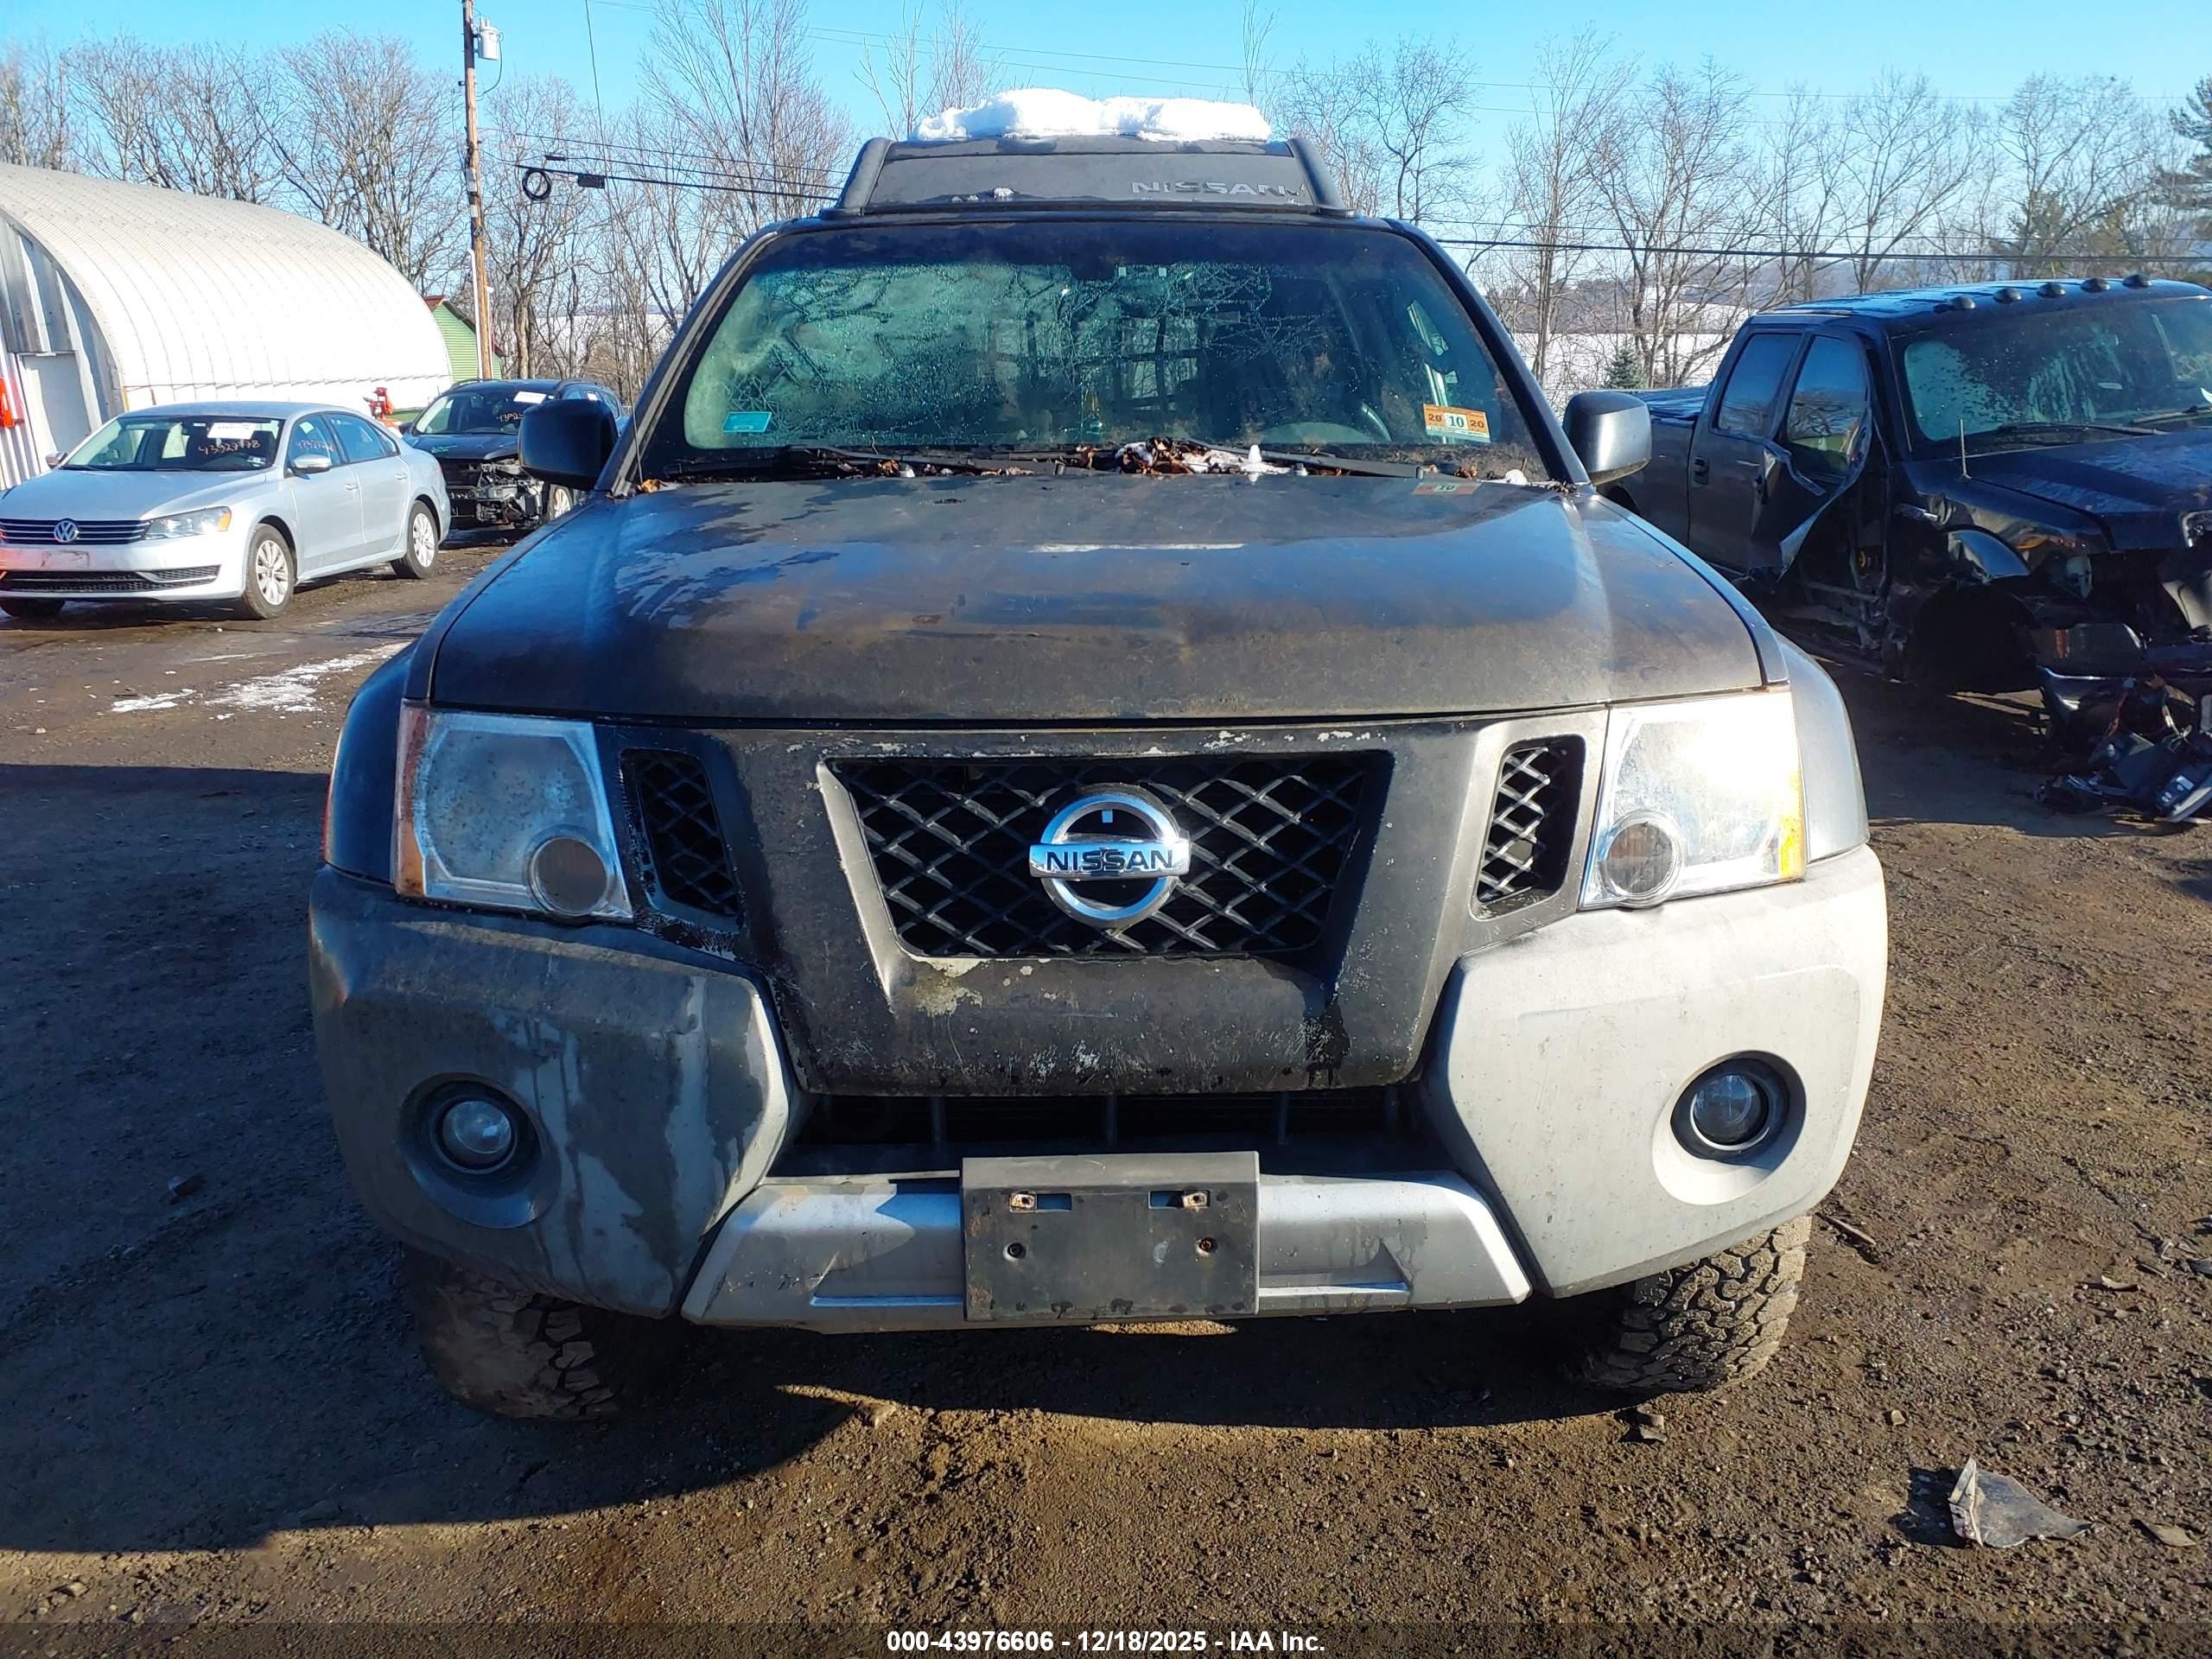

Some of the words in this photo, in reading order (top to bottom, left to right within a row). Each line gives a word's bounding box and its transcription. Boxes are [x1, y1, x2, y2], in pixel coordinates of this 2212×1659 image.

[1131, 180, 1287, 197] NISSAN
[1449, 416, 1464, 428] 10
[1046, 849, 1173, 872] NISSAN
